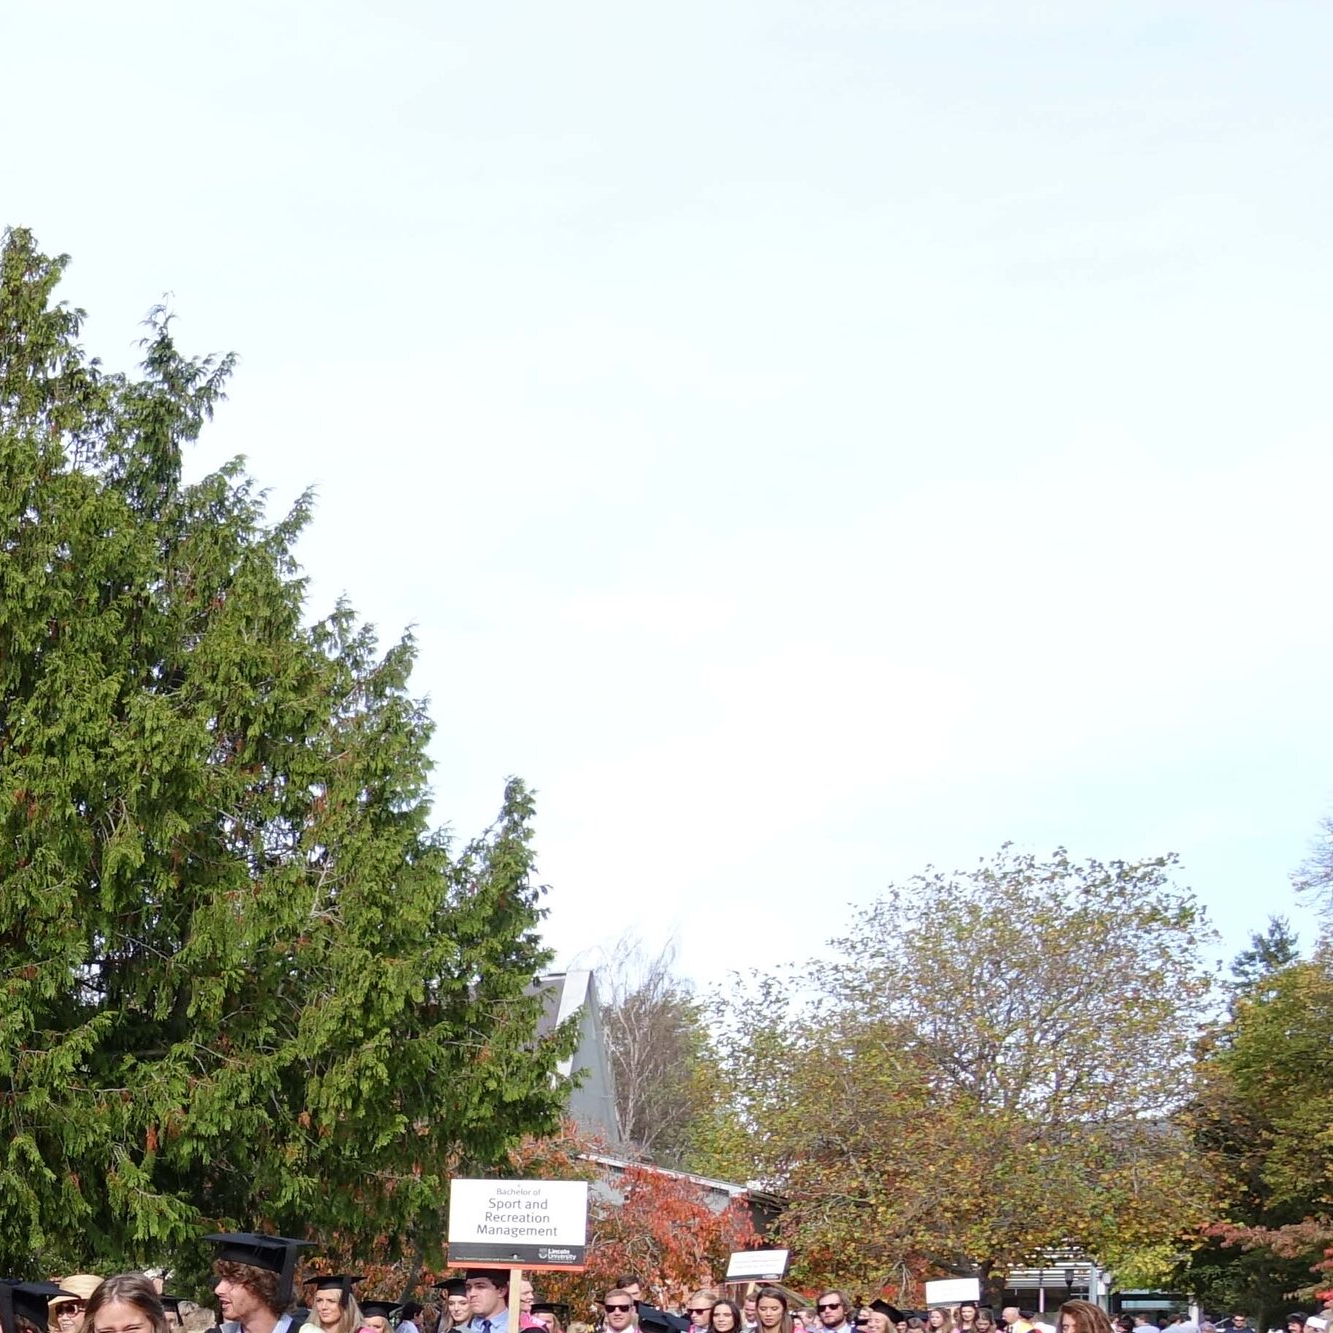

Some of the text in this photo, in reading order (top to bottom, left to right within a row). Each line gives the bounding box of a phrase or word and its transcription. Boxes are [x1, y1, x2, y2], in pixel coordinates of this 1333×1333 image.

[496, 1187, 541, 1196] Bachelor of
[488, 1198, 548, 1211] Sport and
[485, 1212, 550, 1223] Recreation
[476, 1224, 558, 1238] Management
